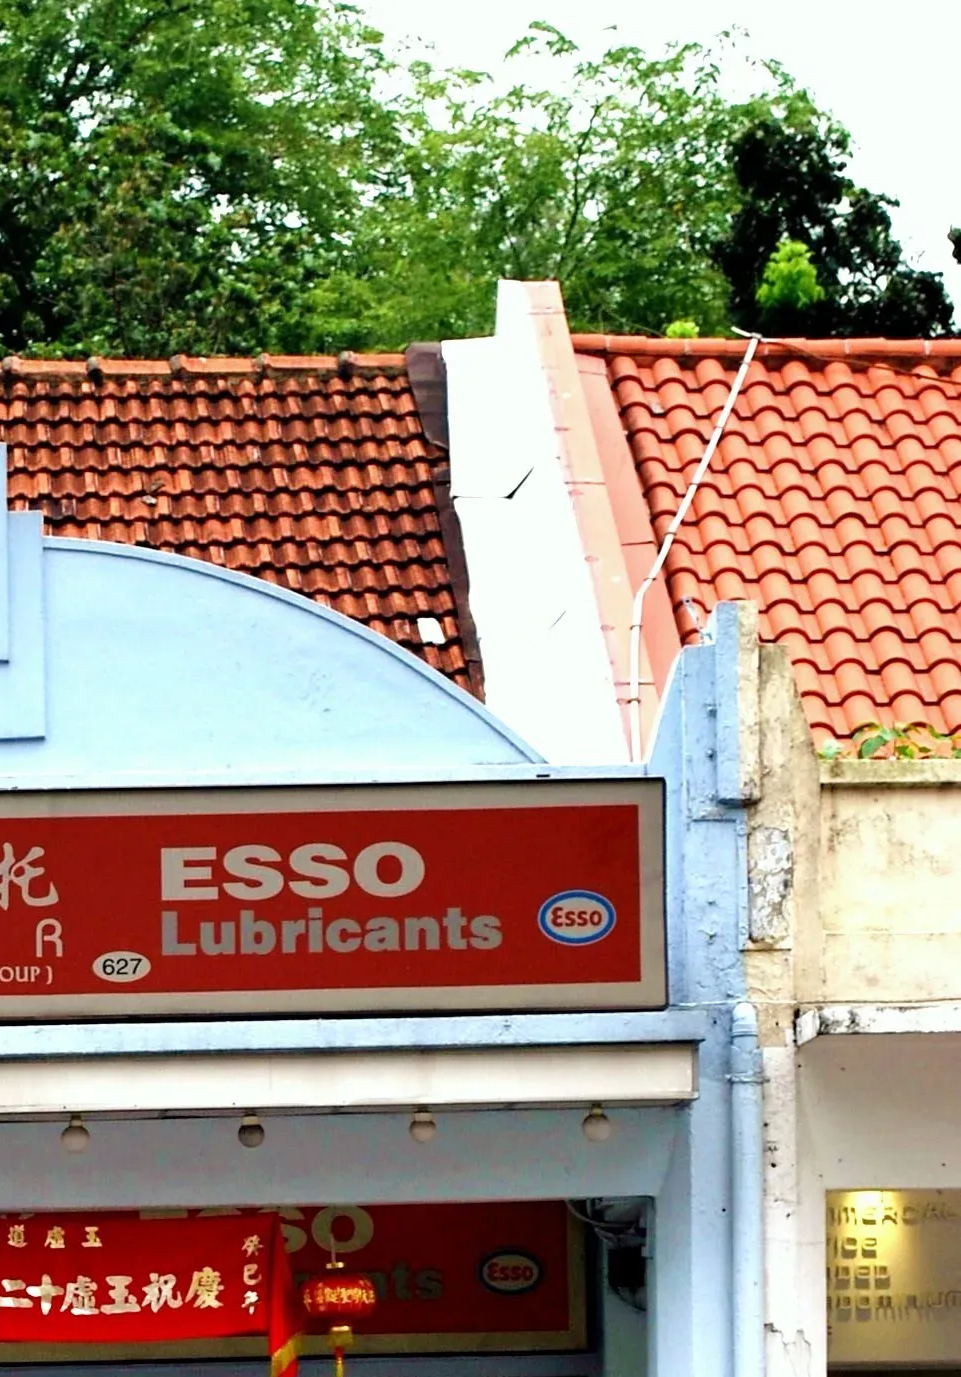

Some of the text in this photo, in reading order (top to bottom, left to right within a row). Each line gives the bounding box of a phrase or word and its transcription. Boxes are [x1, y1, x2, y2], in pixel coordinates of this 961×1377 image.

[160, 841, 426, 901] ESSO
[549, 906, 604, 930] Esso
[160, 906, 503, 956] Lubricants
[101, 956, 144, 977] 627
[488, 1261, 534, 1282] Esso
